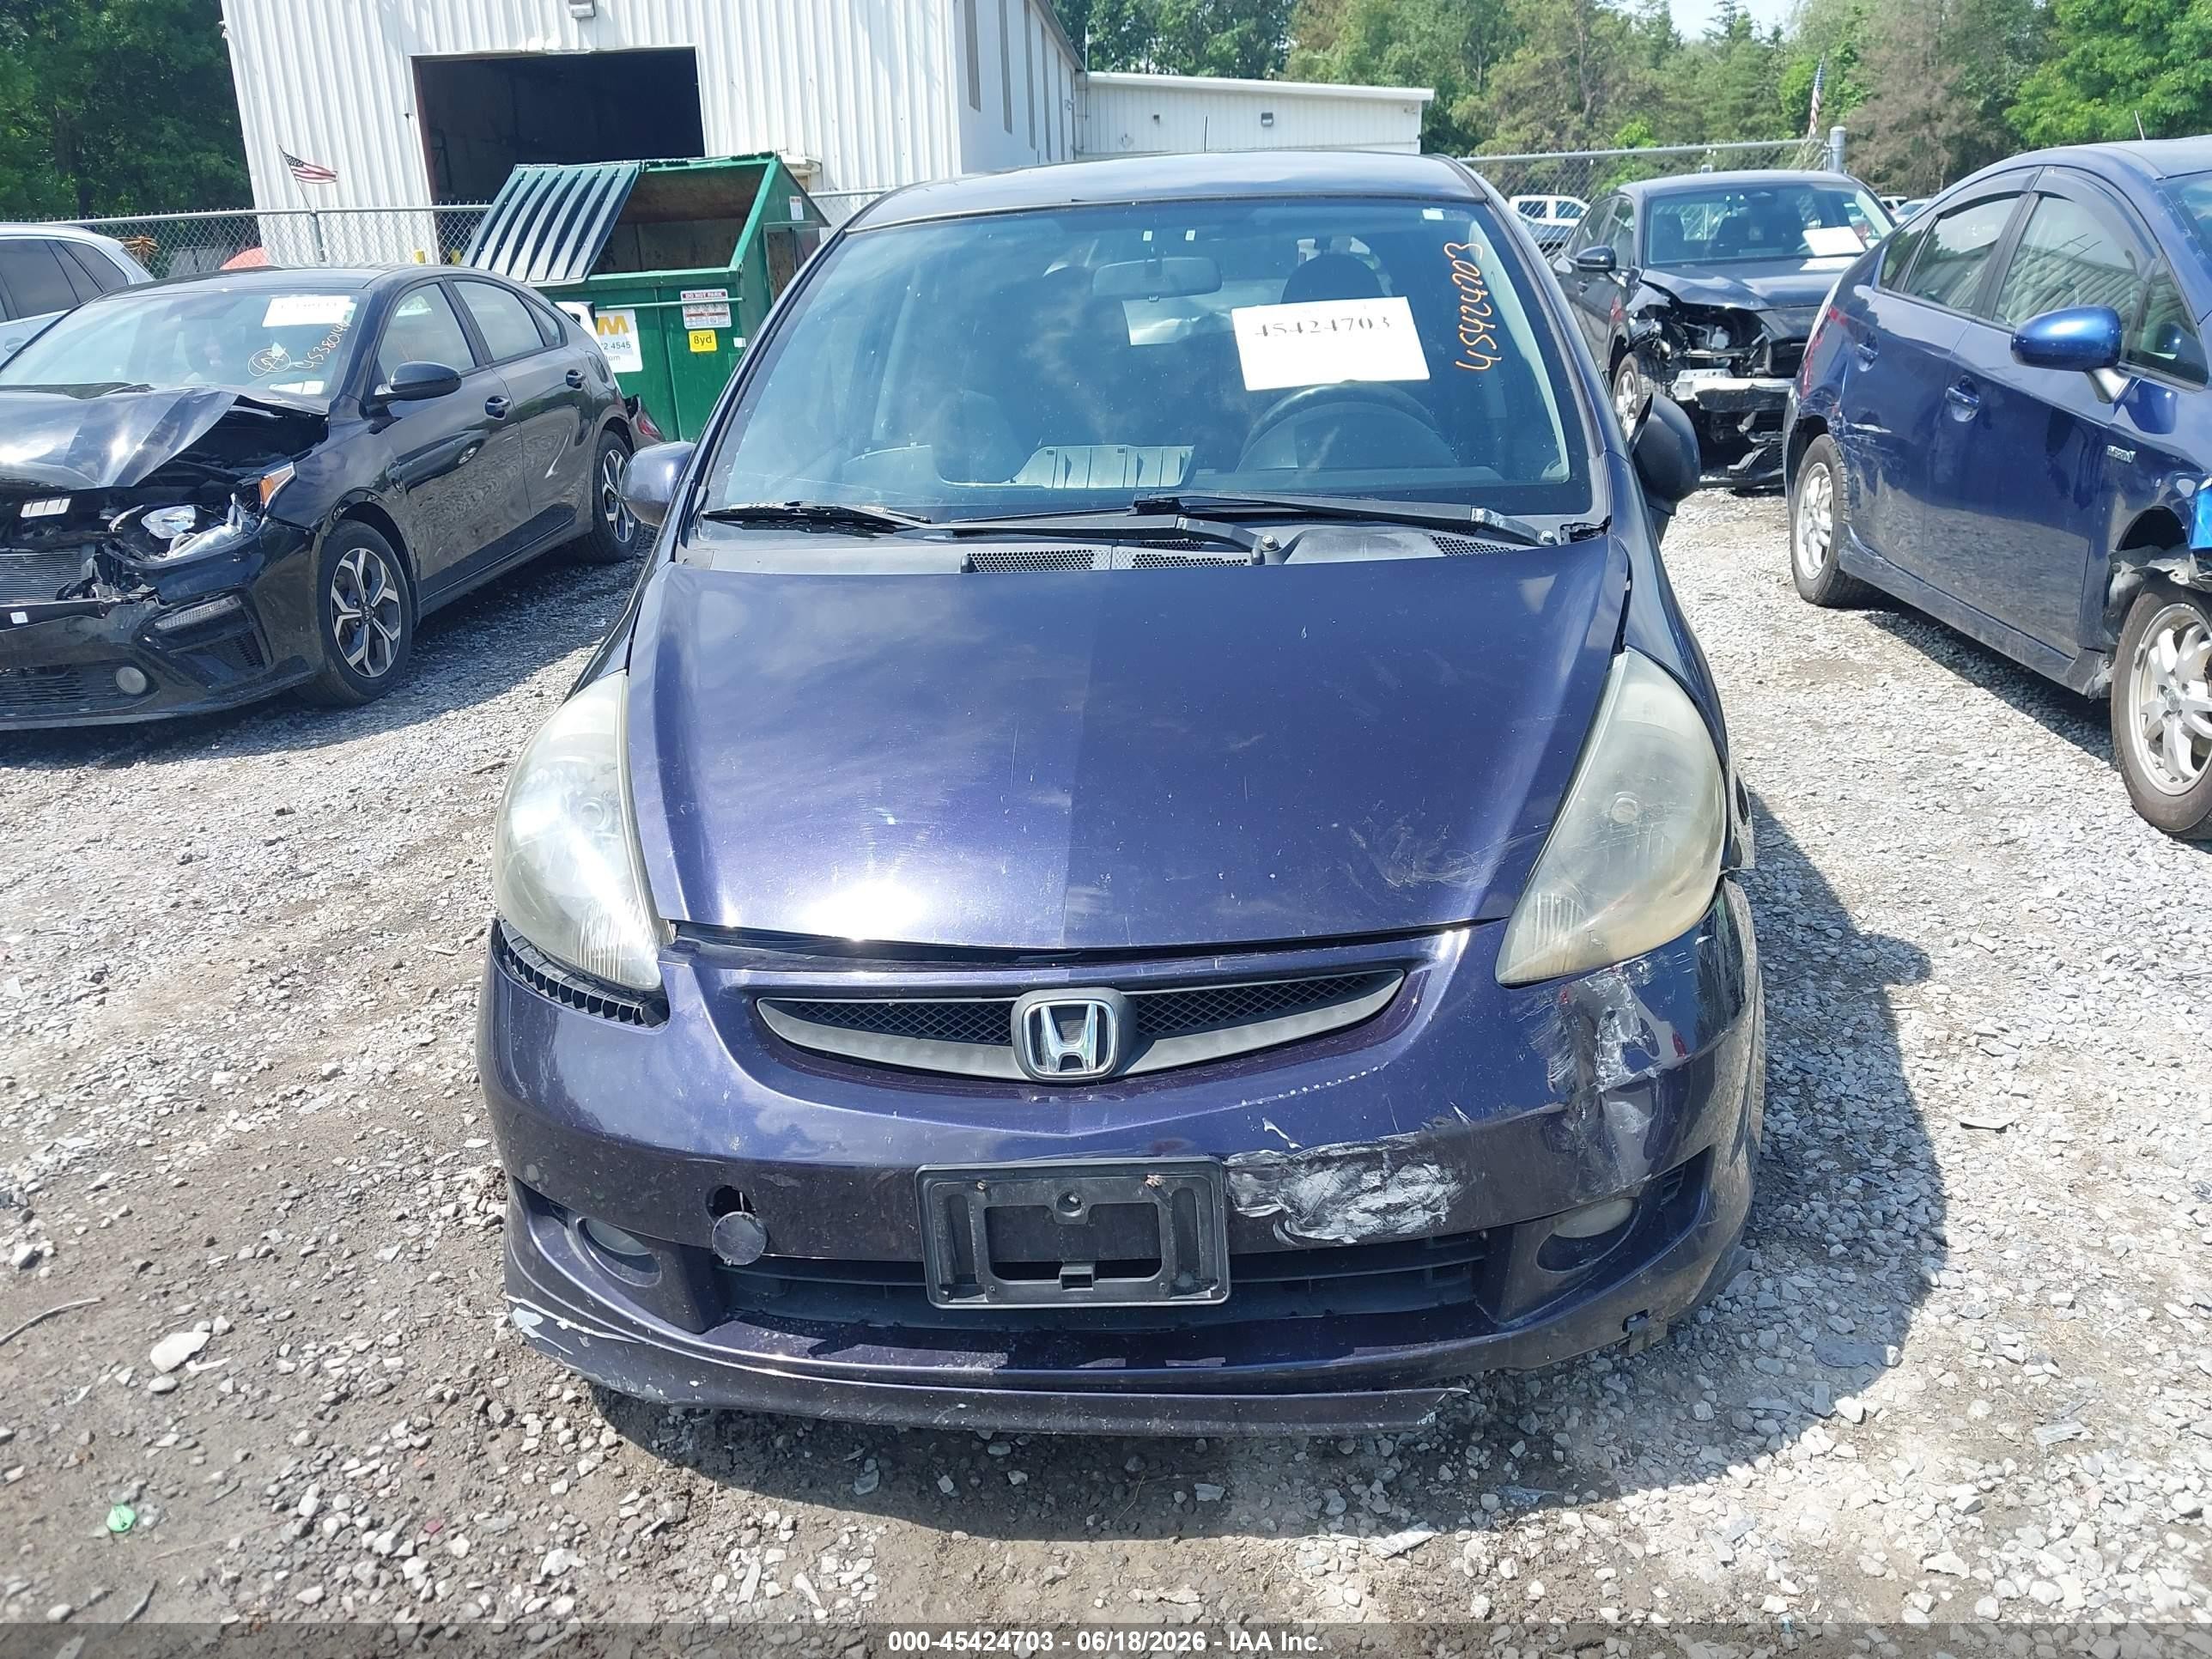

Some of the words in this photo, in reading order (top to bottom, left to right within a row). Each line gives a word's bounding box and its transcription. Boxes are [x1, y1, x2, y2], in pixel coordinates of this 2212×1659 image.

[1443, 242, 1503, 370] 45424703
[1255, 315, 1390, 337] 45424703
[611, 341, 631, 349] 4545
[693, 335, 713, 346] 8yd
